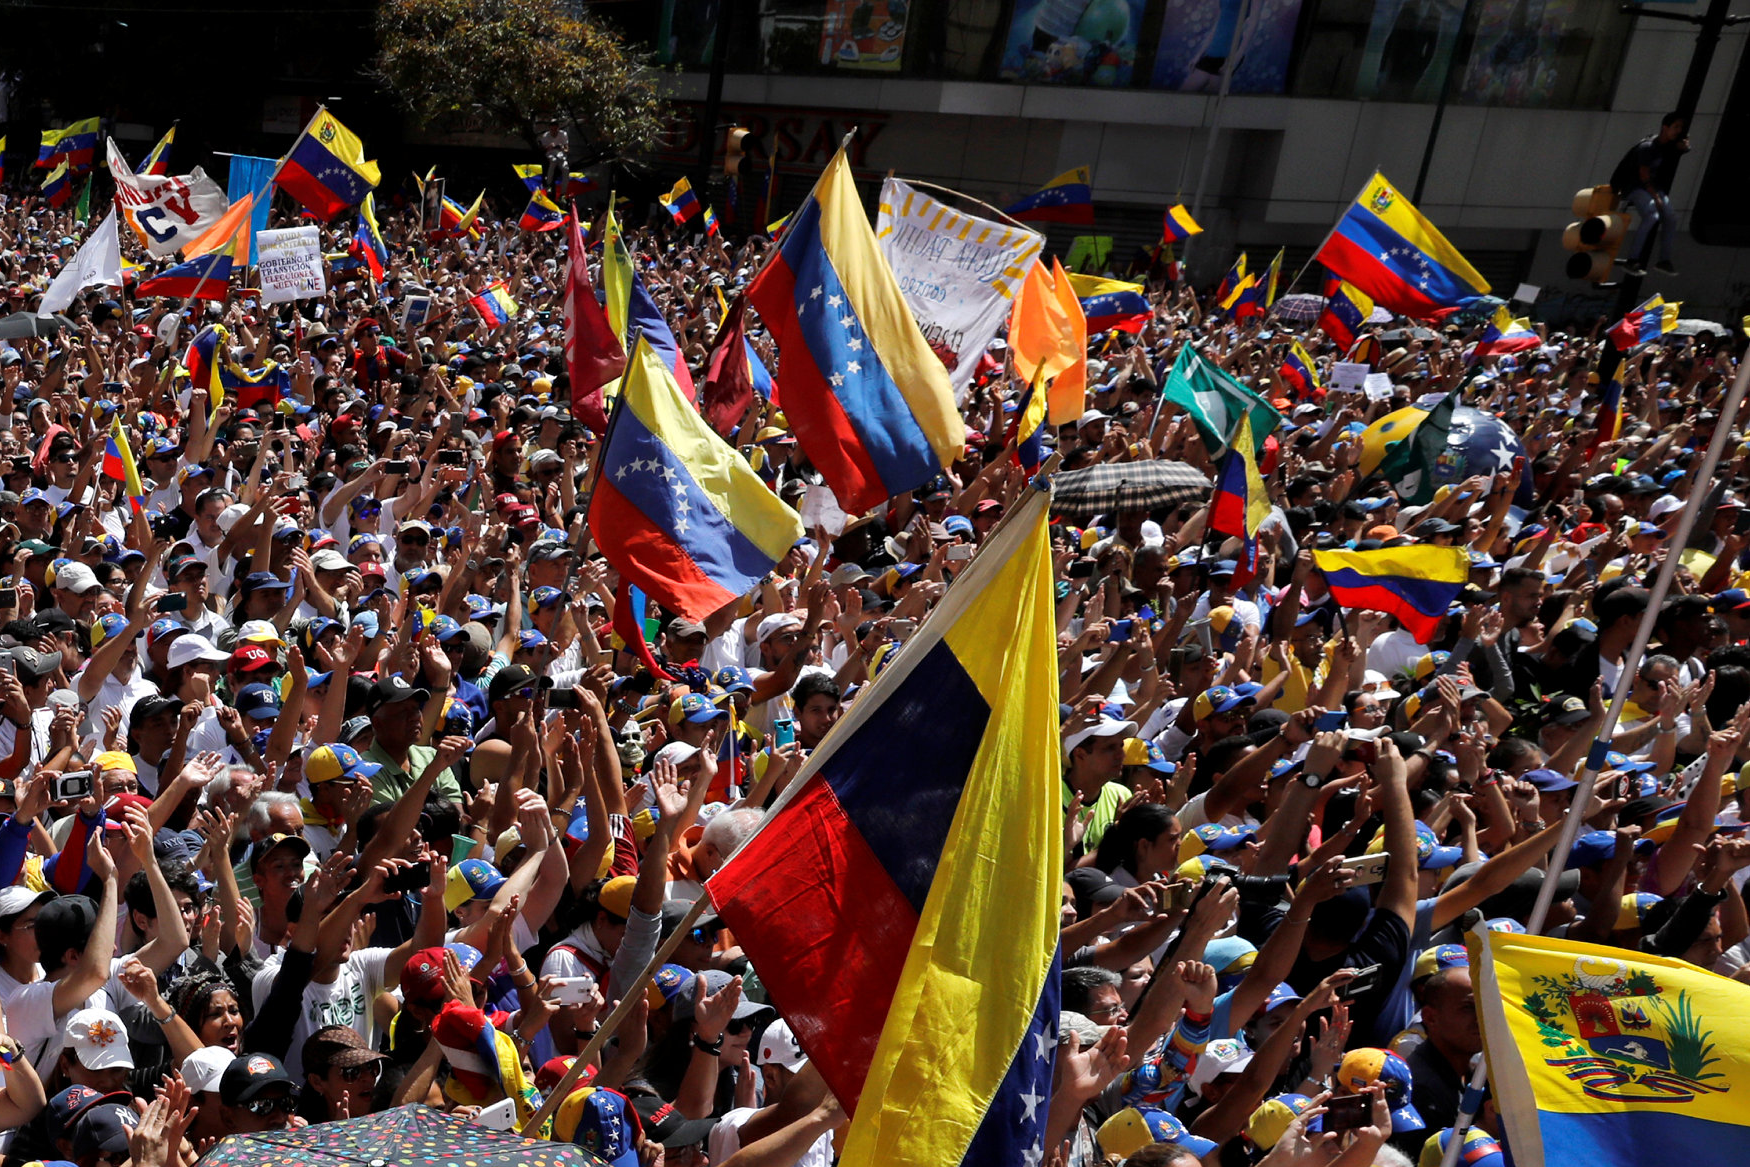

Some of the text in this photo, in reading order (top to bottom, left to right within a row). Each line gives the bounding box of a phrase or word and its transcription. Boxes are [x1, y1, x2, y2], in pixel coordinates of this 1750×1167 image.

[275, 231, 303, 242] AYUDA
[259, 253, 315, 269] GOBIERNO DE
[264, 270, 314, 284] ELECCIONES
[273, 277, 321, 291] NUEVO CNE
[162, 837, 184, 849] NYC
